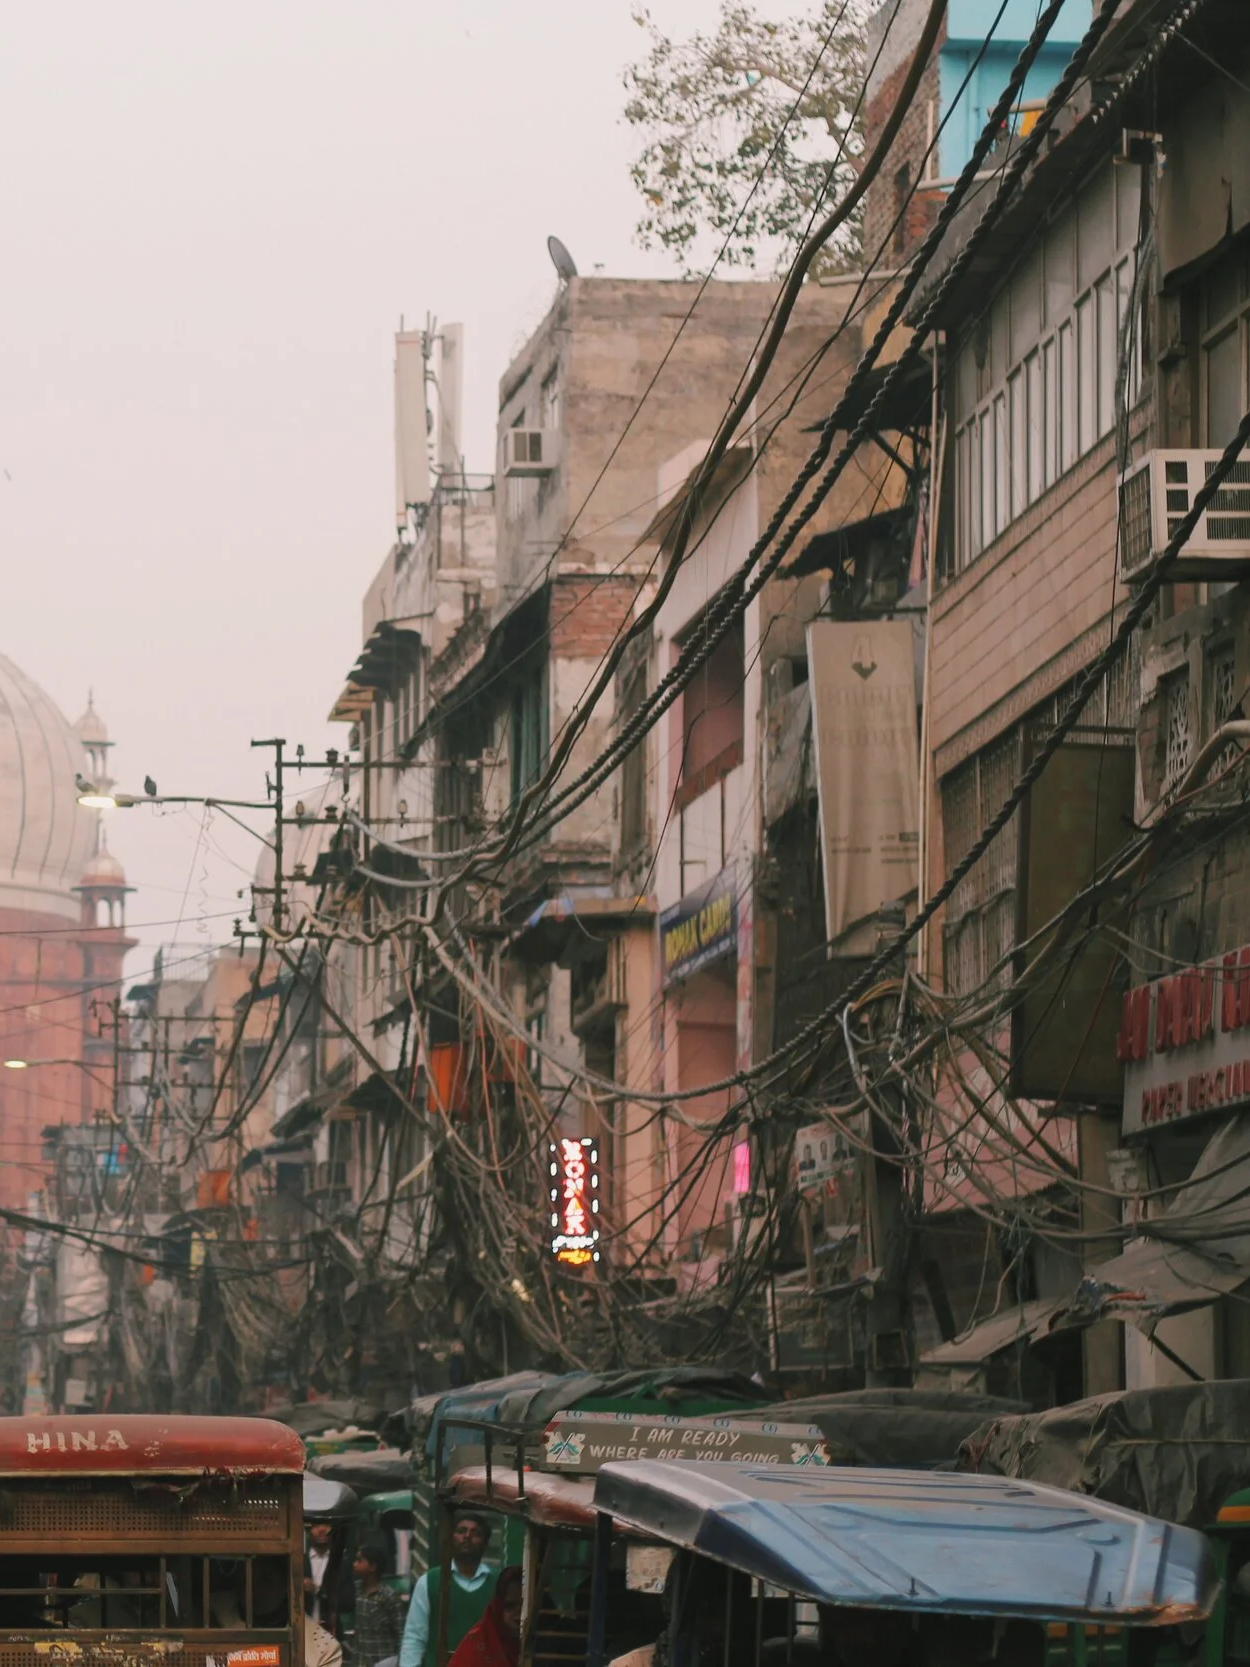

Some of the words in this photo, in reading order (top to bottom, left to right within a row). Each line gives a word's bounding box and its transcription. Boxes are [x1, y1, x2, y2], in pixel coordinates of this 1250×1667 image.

[26, 1429, 129, 1454] HINA
[628, 1426, 641, 1442] I
[647, 1428, 674, 1443] AM
[681, 1429, 741, 1447] READY
[589, 1444, 648, 1460] WHERE
[657, 1447, 685, 1461] ARE
[695, 1450, 723, 1461] YOU
[730, 1452, 780, 1464] GOING
